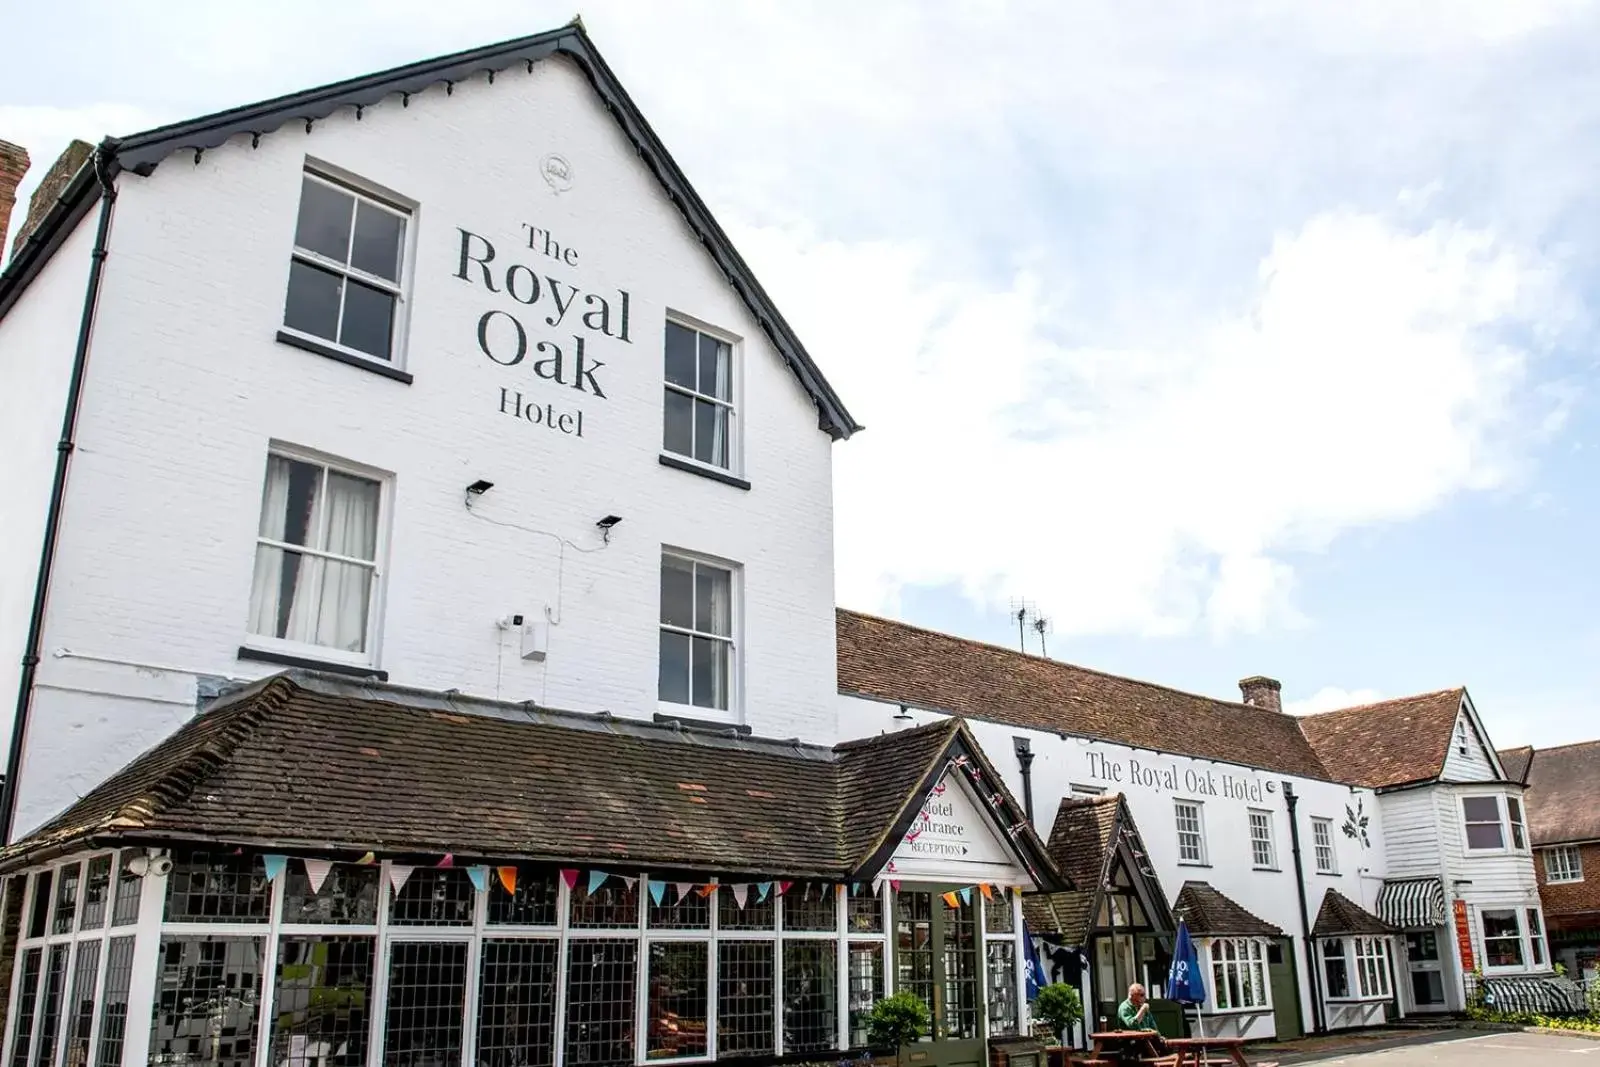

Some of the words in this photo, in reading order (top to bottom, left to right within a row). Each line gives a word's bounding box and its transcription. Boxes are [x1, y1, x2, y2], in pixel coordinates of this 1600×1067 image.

[521, 222, 579, 268] The
[452, 228, 633, 345] Royal
[477, 309, 608, 400] Oak
[498, 387, 584, 438] Hotel
[1085, 751, 1122, 783] The
[1129, 759, 1179, 793] Royal
[1184, 768, 1218, 798] Oak
[1222, 774, 1264, 803] Hotel
[911, 843, 961, 855] RECEPTION
